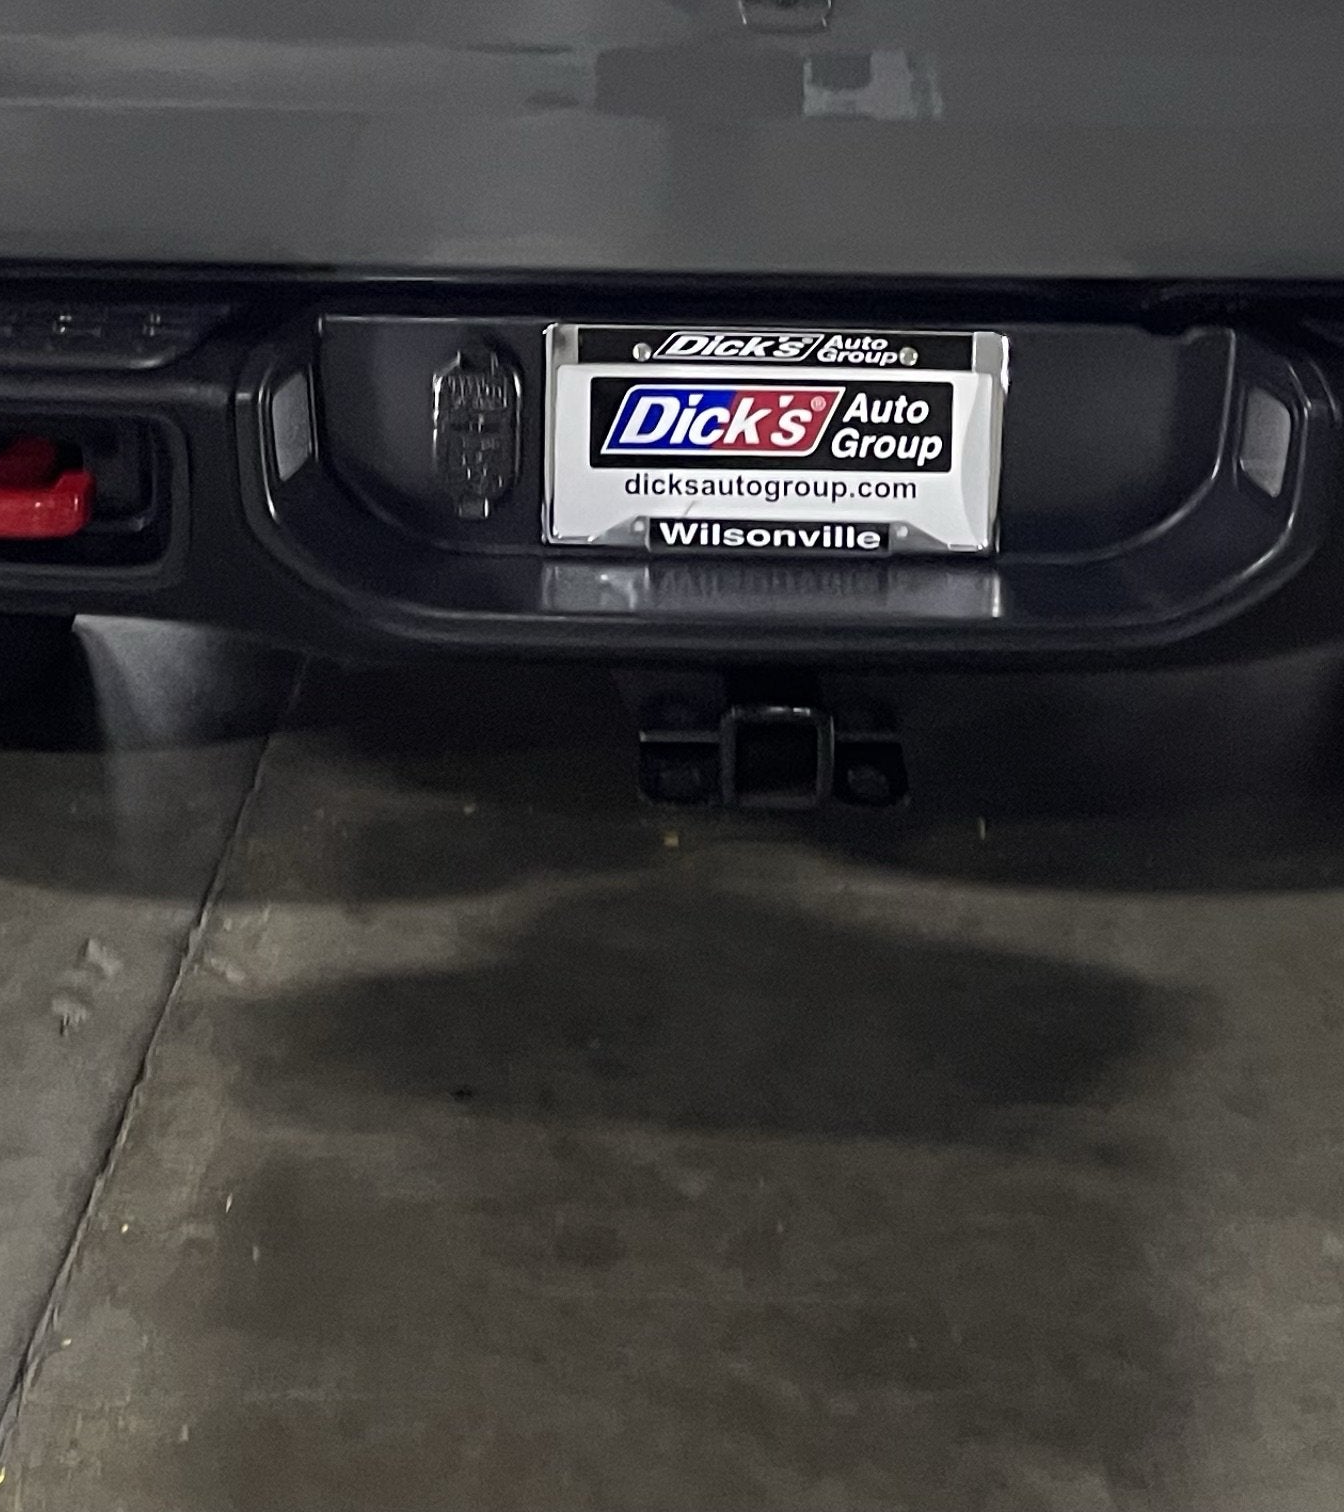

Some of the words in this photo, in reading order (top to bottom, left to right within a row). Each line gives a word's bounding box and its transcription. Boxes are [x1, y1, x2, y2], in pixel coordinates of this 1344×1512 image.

[667, 336, 806, 358] Dick's
[824, 335, 889, 351] Auto
[816, 348, 898, 367] Group
[618, 393, 814, 448] Dick's
[842, 393, 930, 426] Auto
[830, 427, 944, 467] Group
[624, 474, 918, 501] dicksautogroup.com
[659, 521, 881, 550] Wilsonville
